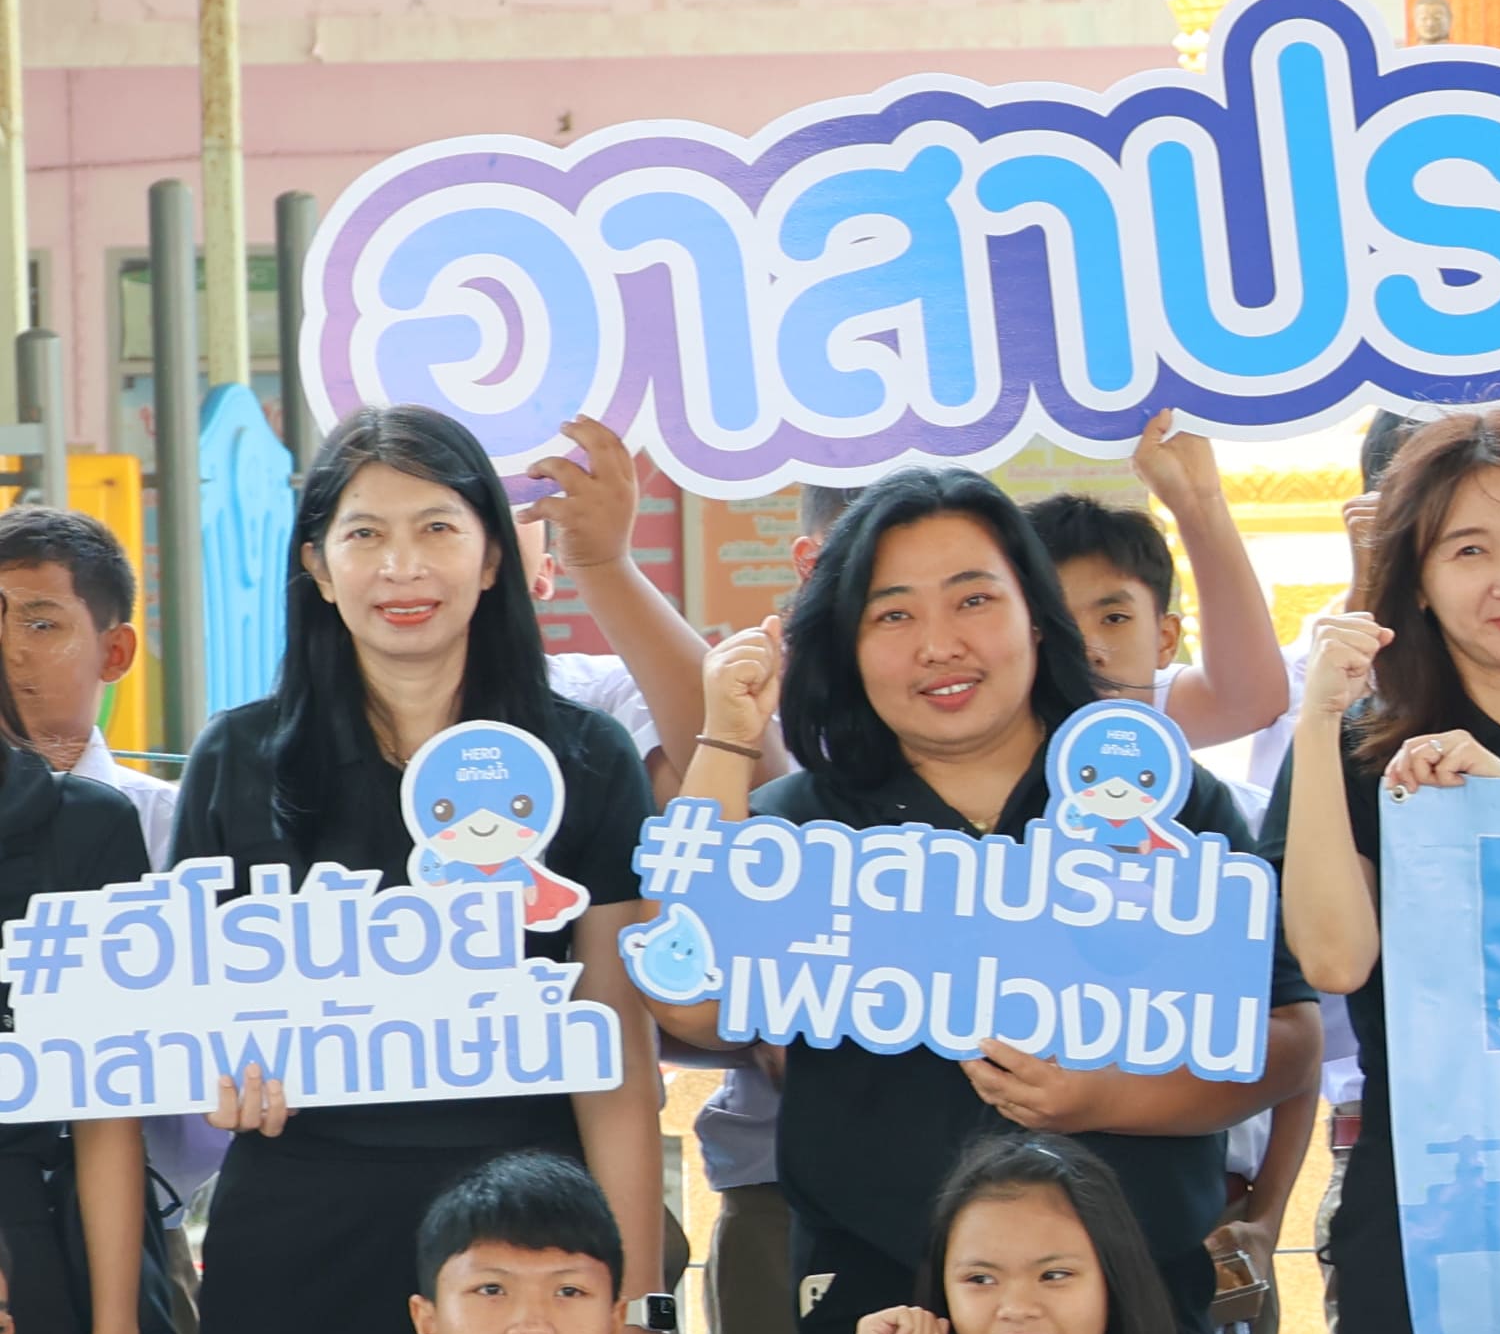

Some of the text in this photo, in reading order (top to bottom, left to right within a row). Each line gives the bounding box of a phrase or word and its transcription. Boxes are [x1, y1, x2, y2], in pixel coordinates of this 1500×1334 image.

[461, 747, 500, 760] HERO
[1106, 730, 1137, 741] HERO
[6, 865, 517, 995] #ฮีโร่น้อย
[641, 804, 1268, 941] #อาสาประปา
[727, 914, 1259, 1073] เพื่อปวงชน
